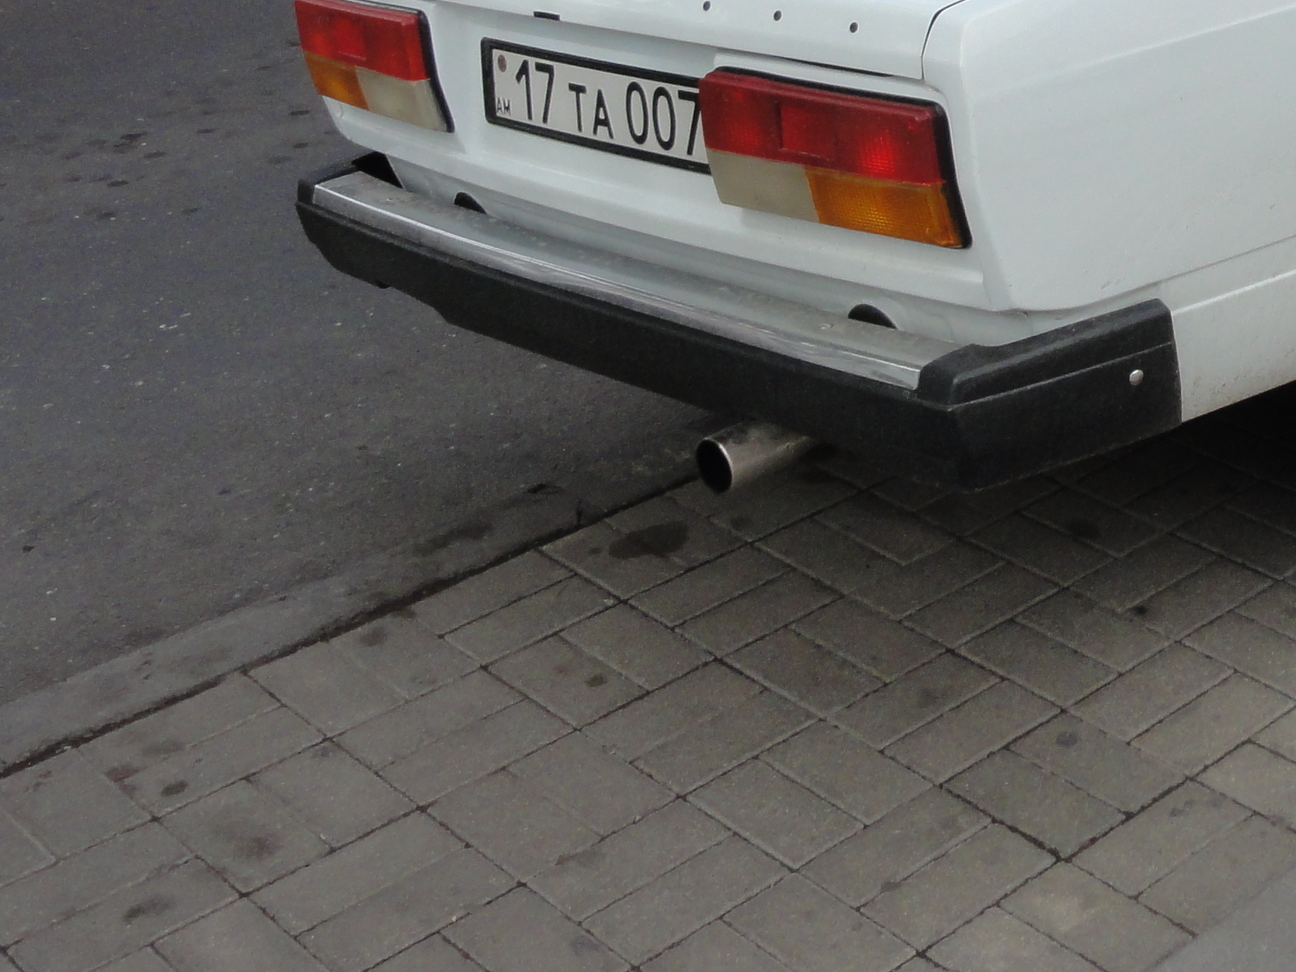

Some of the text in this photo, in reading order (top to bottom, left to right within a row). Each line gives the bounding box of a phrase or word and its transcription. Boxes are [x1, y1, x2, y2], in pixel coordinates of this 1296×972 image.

[496, 99, 512, 115] AM
[515, 59, 701, 156] 17 TA 007
